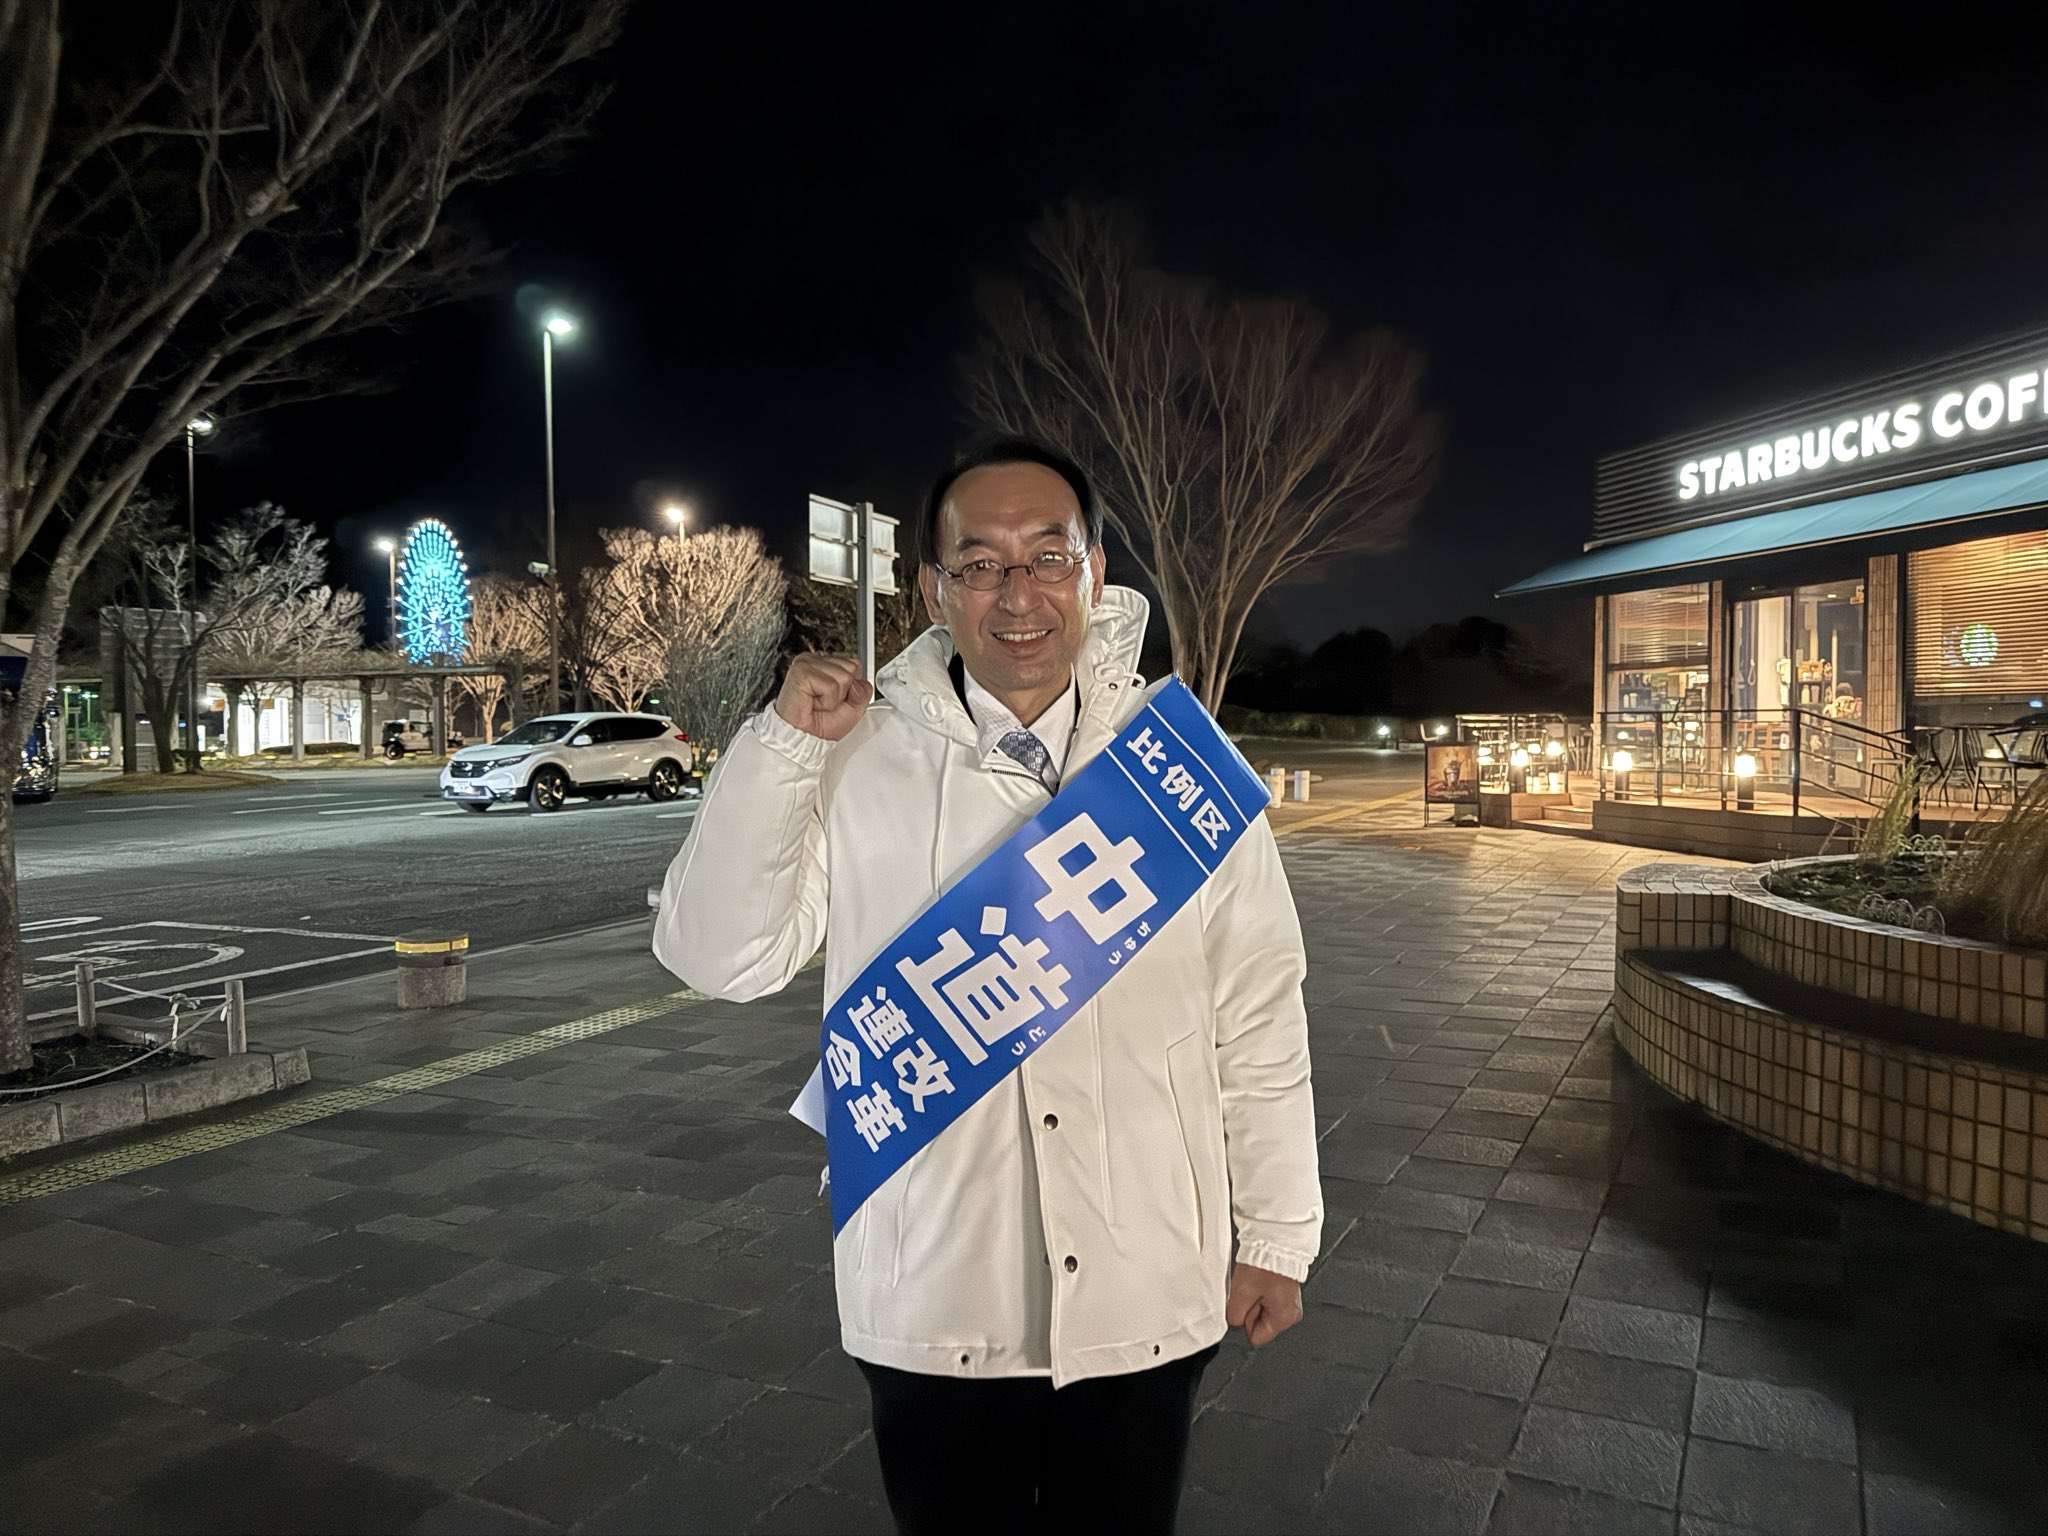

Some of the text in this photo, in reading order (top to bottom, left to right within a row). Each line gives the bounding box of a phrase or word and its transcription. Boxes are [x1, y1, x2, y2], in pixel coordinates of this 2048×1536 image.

[1678, 368, 2048, 501] STARBUCKS COF
[1125, 726, 1232, 852] 比例区
[894, 811, 1159, 1067] 中道
[825, 985, 915, 1091] 連合
[846, 1036, 957, 1154] 改革
[1011, 1024, 1047, 1057] どう
